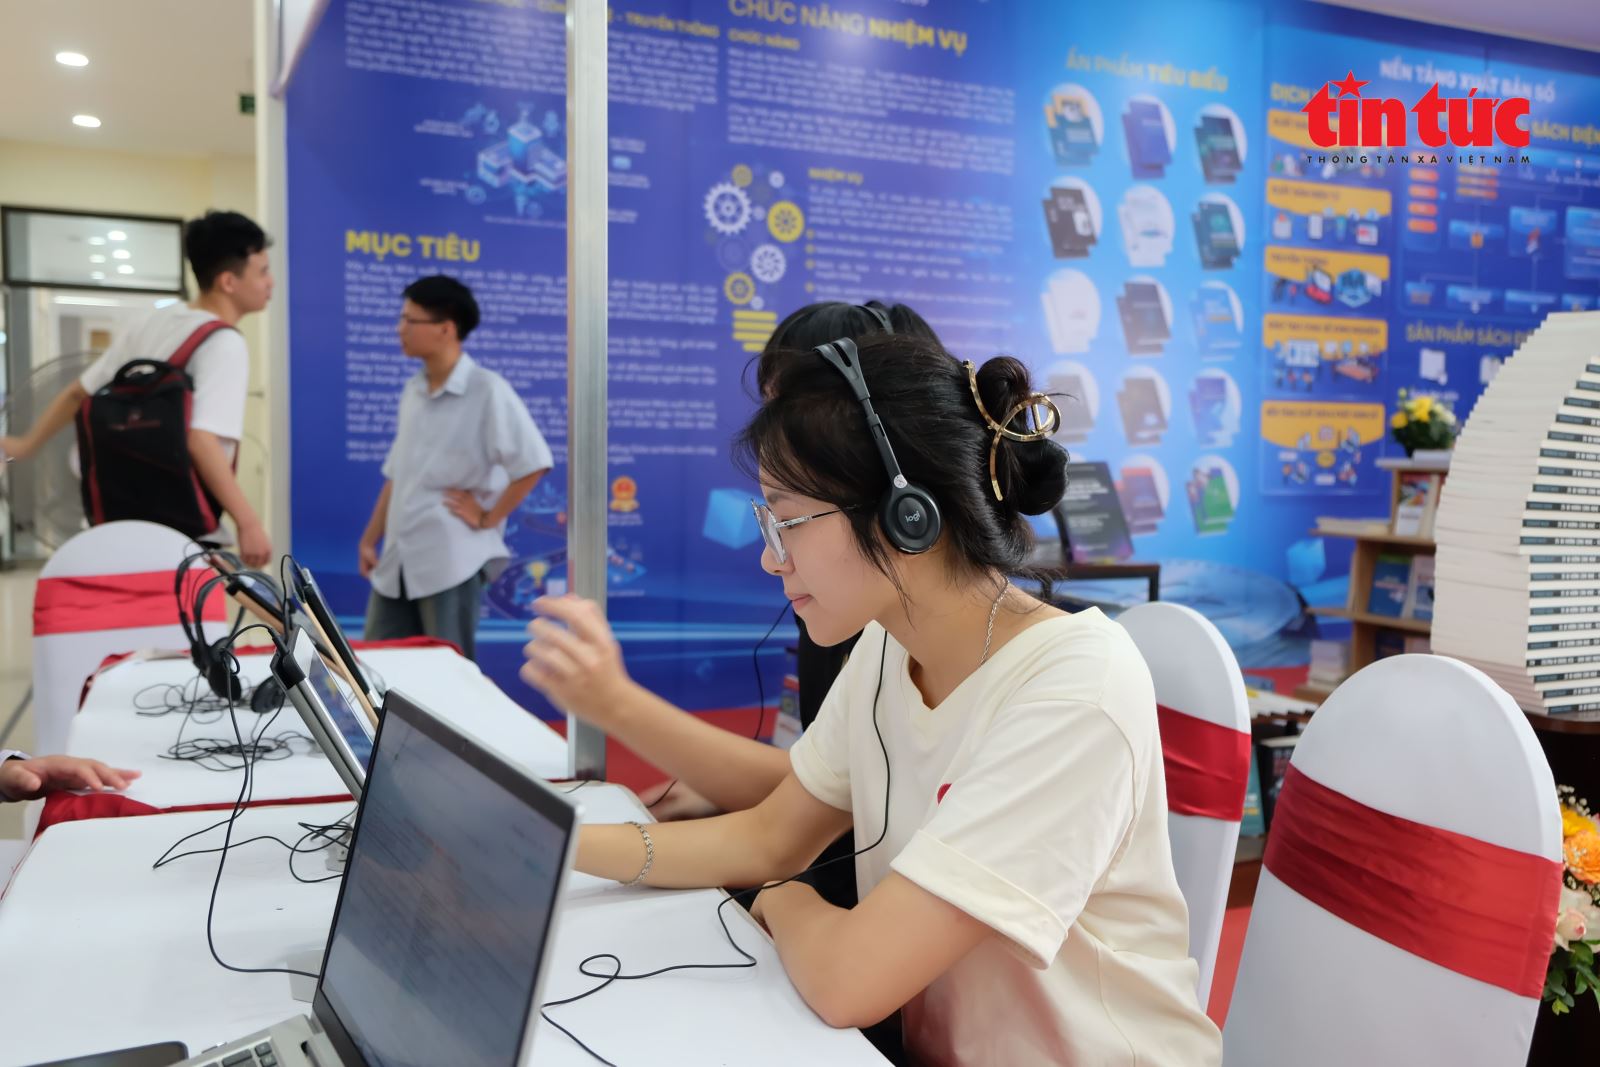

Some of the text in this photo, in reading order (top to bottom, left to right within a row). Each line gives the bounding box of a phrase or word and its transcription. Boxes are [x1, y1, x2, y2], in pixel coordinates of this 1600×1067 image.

[937, 27, 968, 57] VỤ
[345, 229, 481, 262] MỤC TIÊU
